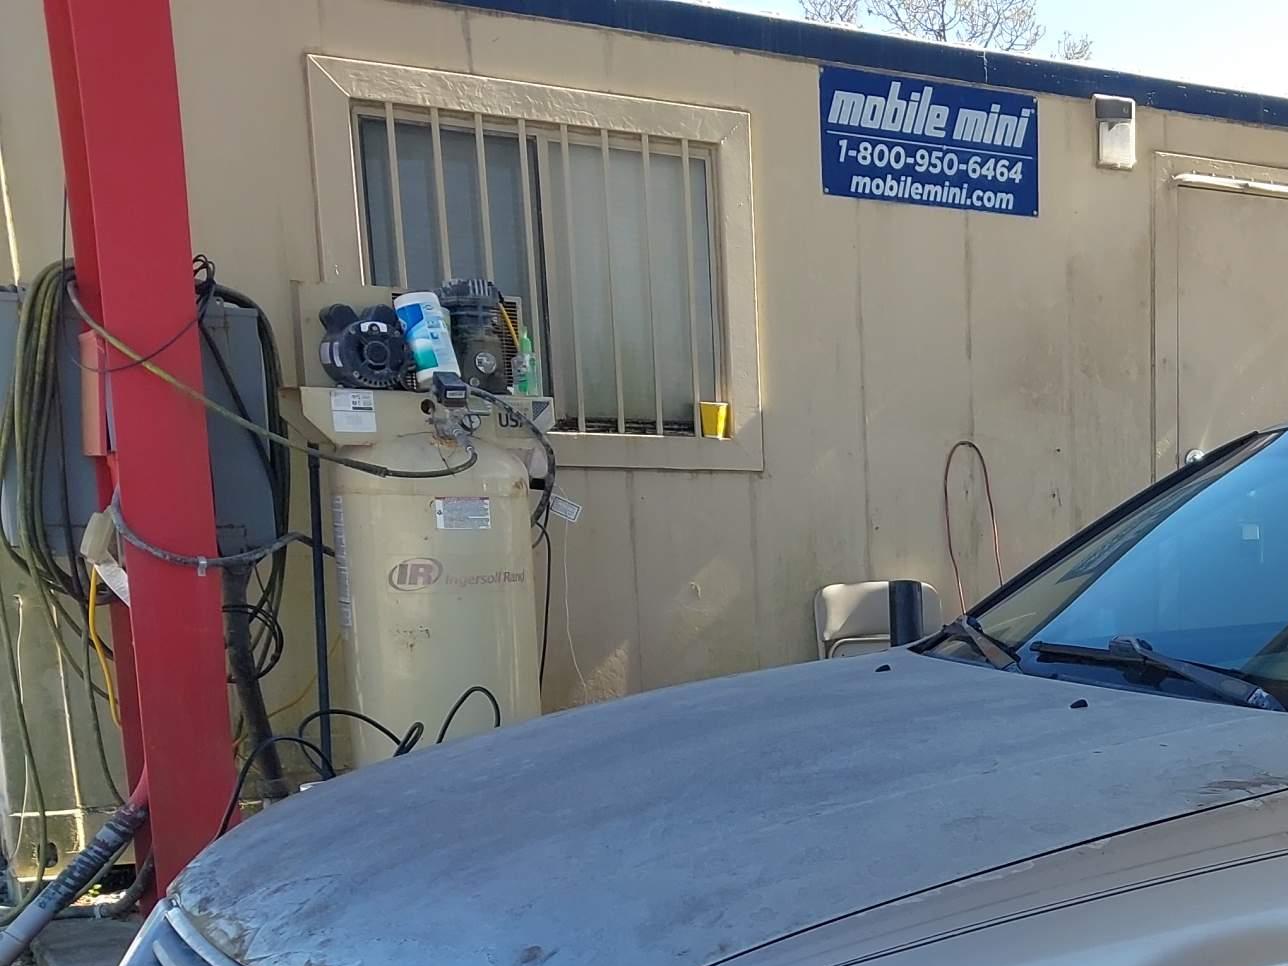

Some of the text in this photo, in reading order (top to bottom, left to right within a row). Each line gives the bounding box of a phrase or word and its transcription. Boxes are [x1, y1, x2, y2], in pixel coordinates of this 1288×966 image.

[827, 81, 1031, 148] mobile mini
[838, 139, 1023, 184] 1-800-950-6464
[850, 174, 1015, 210] mobilemini.com
